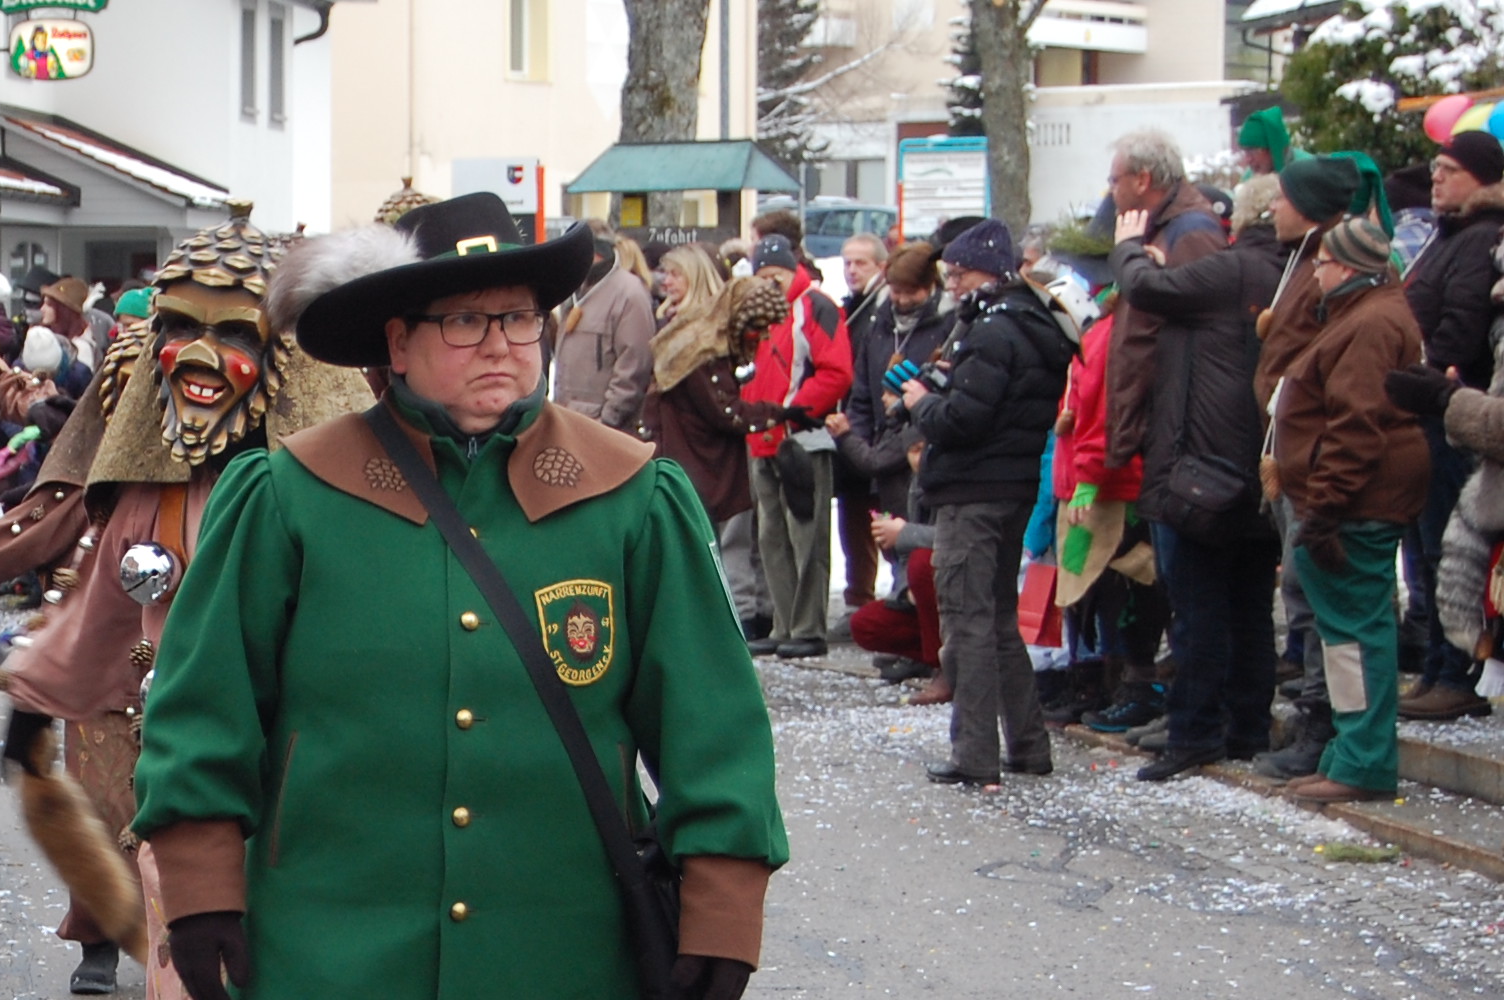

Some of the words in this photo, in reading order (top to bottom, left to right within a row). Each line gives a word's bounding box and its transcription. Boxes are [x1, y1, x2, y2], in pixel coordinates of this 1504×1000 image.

[649, 228, 697, 245] Zufahrt
[540, 585, 608, 605] NARRENZUNFT
[546, 623, 559, 635] 19
